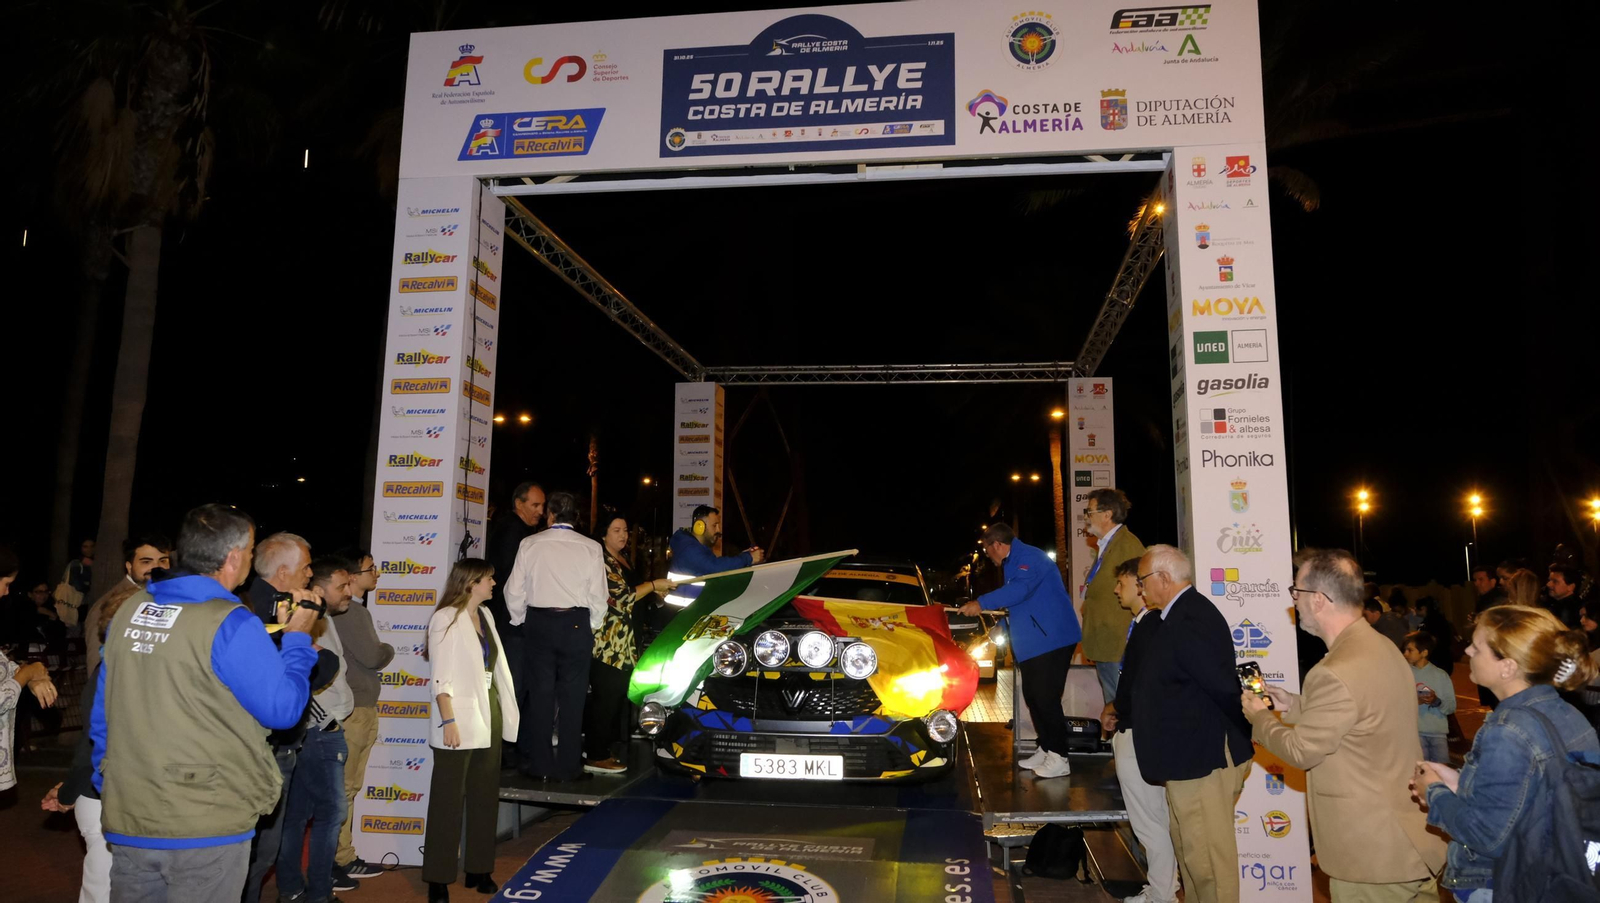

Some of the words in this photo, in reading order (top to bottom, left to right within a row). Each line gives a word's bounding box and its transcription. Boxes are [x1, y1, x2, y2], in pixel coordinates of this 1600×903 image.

[1045, 18, 1060, 36] CLUB
[1112, 40, 1168, 54] Andalucía
[688, 72, 743, 100] 50
[746, 62, 927, 98] RALLYE
[687, 102, 765, 121] COSTA
[771, 101, 804, 117] DE
[809, 93, 923, 115] ALMERÍA
[1012, 103, 1062, 115] COSTA
[1063, 102, 1082, 113] DE
[1136, 95, 1235, 112] DIPUTACIÓN
[513, 114, 587, 132] CERA
[998, 114, 1084, 134] ALMERÍA
[1136, 115, 1156, 127] DE
[1161, 112, 1232, 126] ALMERÍA
[526, 139, 572, 152] Recalvi
[421, 207, 459, 215] MICHELIN
[405, 252, 458, 264] Rallycar
[410, 280, 446, 290] Recalvi
[1192, 296, 1266, 317] MOYA
[397, 351, 450, 364] Rallycar
[402, 381, 439, 391] Recalvi
[1197, 373, 1269, 396] gasolia
[1227, 407, 1246, 415] Grupo
[1228, 414, 1270, 423] Fornieles
[1229, 425, 1237, 433] &
[1239, 424, 1271, 433] albesa
[389, 454, 443, 467] Rallycar
[1074, 454, 1110, 464] MOYA
[1202, 449, 1274, 468] Phonika
[394, 484, 432, 495] Recalvi
[1216, 527, 1264, 555] Enix
[381, 560, 436, 574] Rallycar
[386, 591, 424, 603] Recalvi
[1225, 578, 1280, 607] garcía
[381, 704, 419, 715] Recalvi
[754, 758, 797, 775] 5383
[804, 760, 838, 776] MKL
[367, 786, 425, 801] Rallycar
[373, 819, 413, 831] Recalvi
[698, 864, 782, 876] OMOVIL
[792, 873, 828, 898] CLUB
[1242, 863, 1297, 891] rgar
